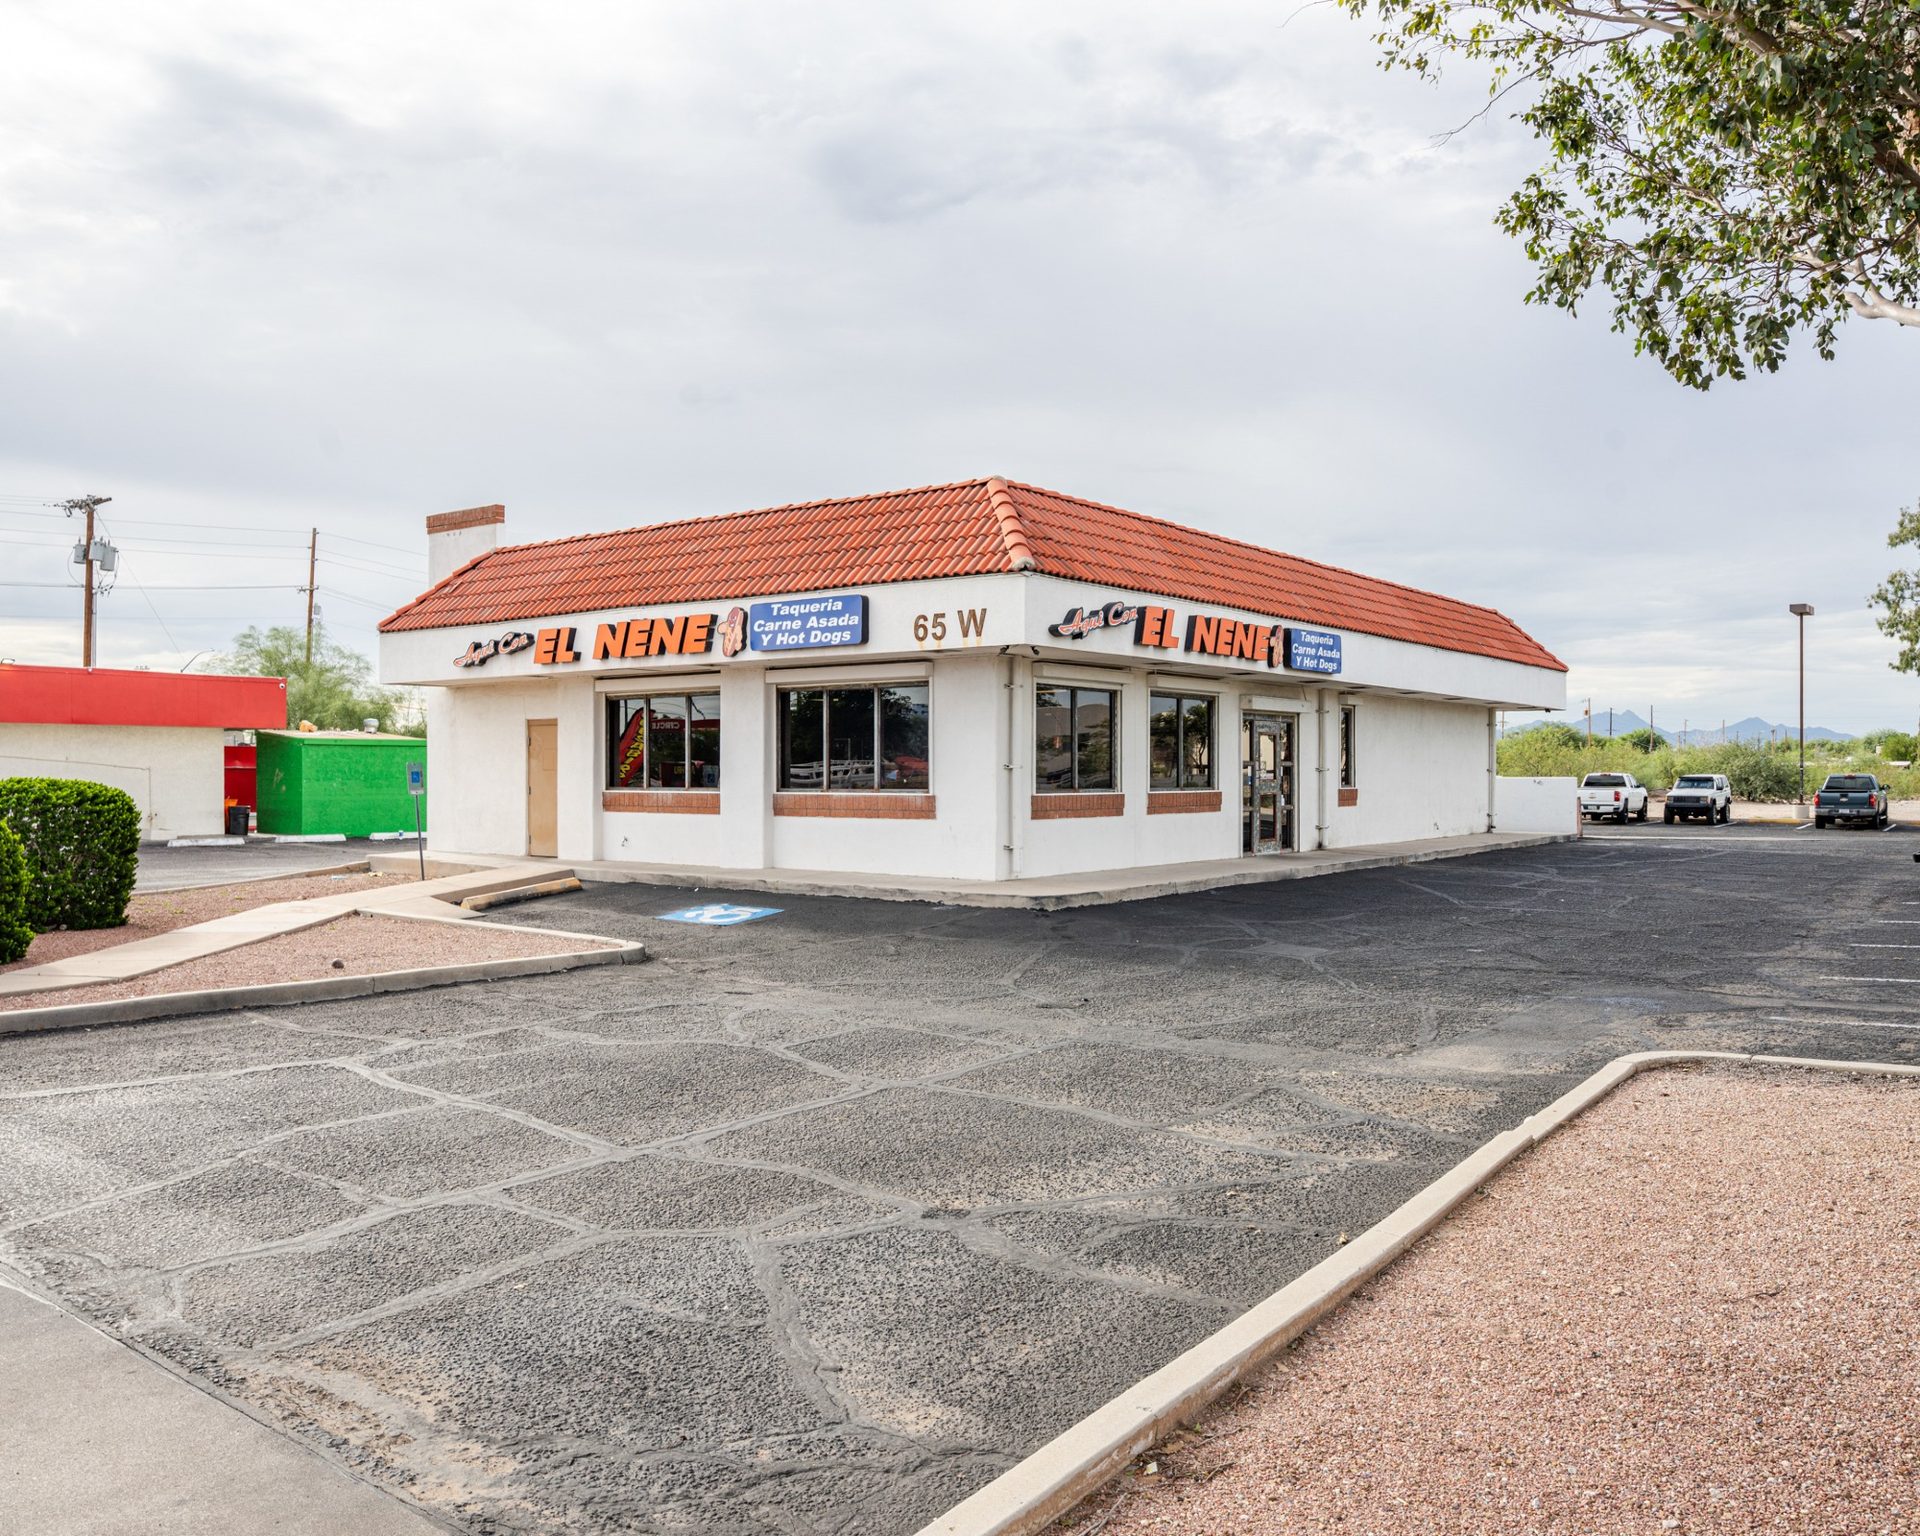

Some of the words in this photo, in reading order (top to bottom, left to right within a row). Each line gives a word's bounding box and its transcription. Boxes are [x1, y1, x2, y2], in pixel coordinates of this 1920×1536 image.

[771, 598, 843, 617] Taqueria
[753, 619, 802, 632] Carne
[806, 613, 859, 629] Asada
[913, 612, 947, 642] 65
[957, 607, 987, 638] W
[1107, 601, 1138, 626] Con
[1140, 605, 1179, 648] EL
[1191, 614, 1271, 661] NENE
[498, 631, 531, 655] Con
[534, 627, 578, 665] EL
[592, 613, 713, 660] NENE
[761, 633, 773, 646] Y
[776, 631, 805, 646] Hot
[809, 630, 851, 645] Dogs
[1301, 631, 1334, 645] Taqueria
[1292, 643, 1316, 656] Carne
[1317, 646, 1340, 659] Asada
[1296, 655, 1302, 666] Y
[1303, 656, 1318, 668] Hot
[1319, 658, 1338, 672] Dogs
